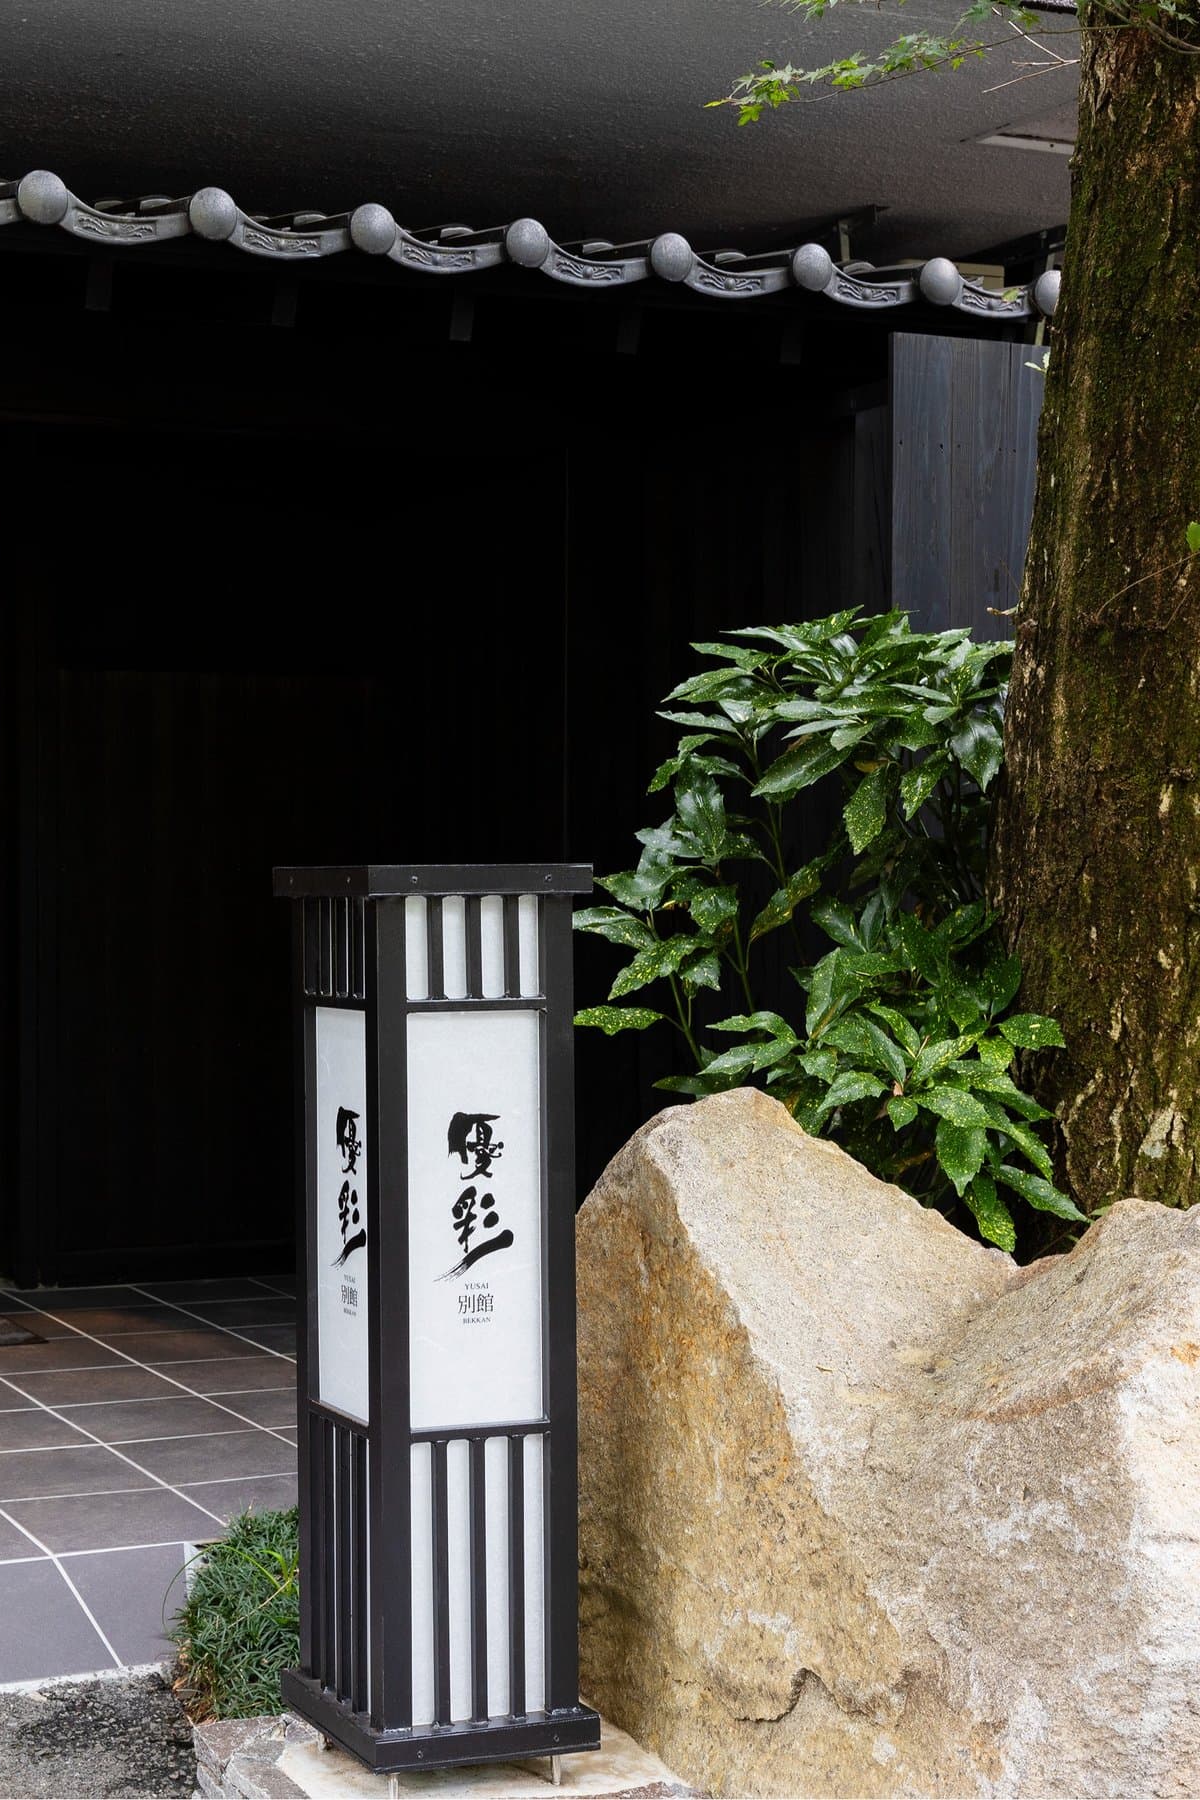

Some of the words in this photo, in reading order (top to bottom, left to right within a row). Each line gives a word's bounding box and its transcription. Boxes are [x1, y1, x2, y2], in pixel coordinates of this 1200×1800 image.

[330, 1106, 366, 1270] 優彩
[433, 1111, 514, 1281] 優彩
[341, 1284, 358, 1307] 別館
[464, 1282, 489, 1290] YUSAI
[458, 1293, 494, 1314] 別館
